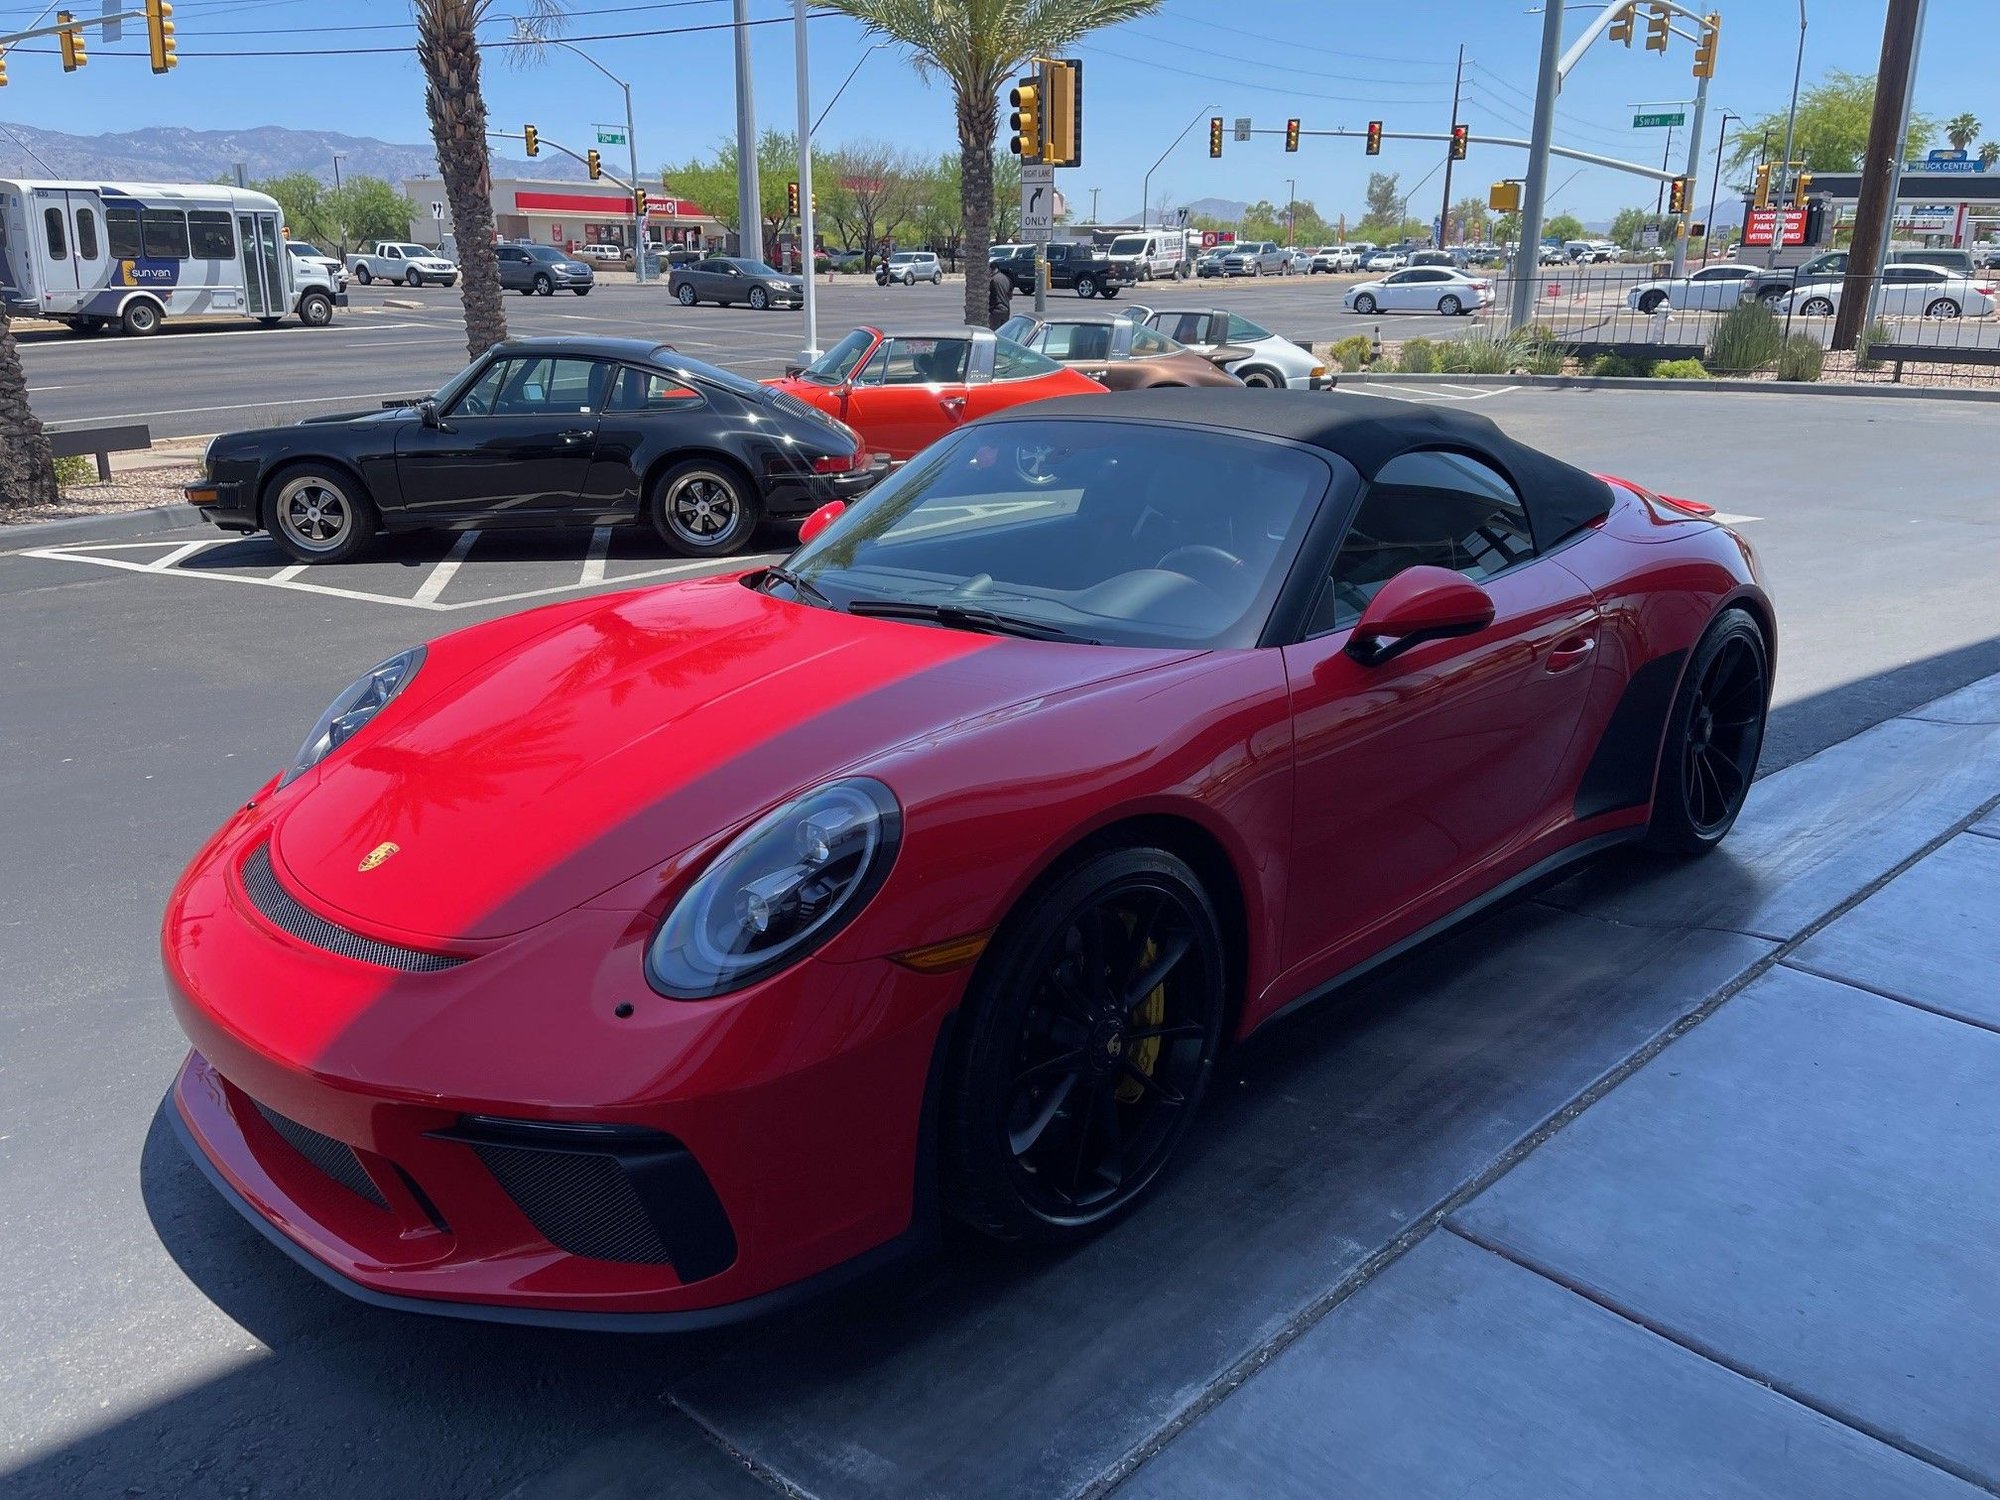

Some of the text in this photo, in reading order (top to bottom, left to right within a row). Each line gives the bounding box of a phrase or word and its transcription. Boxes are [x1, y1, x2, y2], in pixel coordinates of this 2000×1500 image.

[1639, 116, 1660, 126] Swan
[1916, 162, 1974, 170] TRUCK CENTER
[1039, 169, 1052, 178] LANE
[646, 203, 666, 211] CIRCLE
[1025, 216, 1048, 226] ONLY
[1717, 232, 1728, 240] 40
